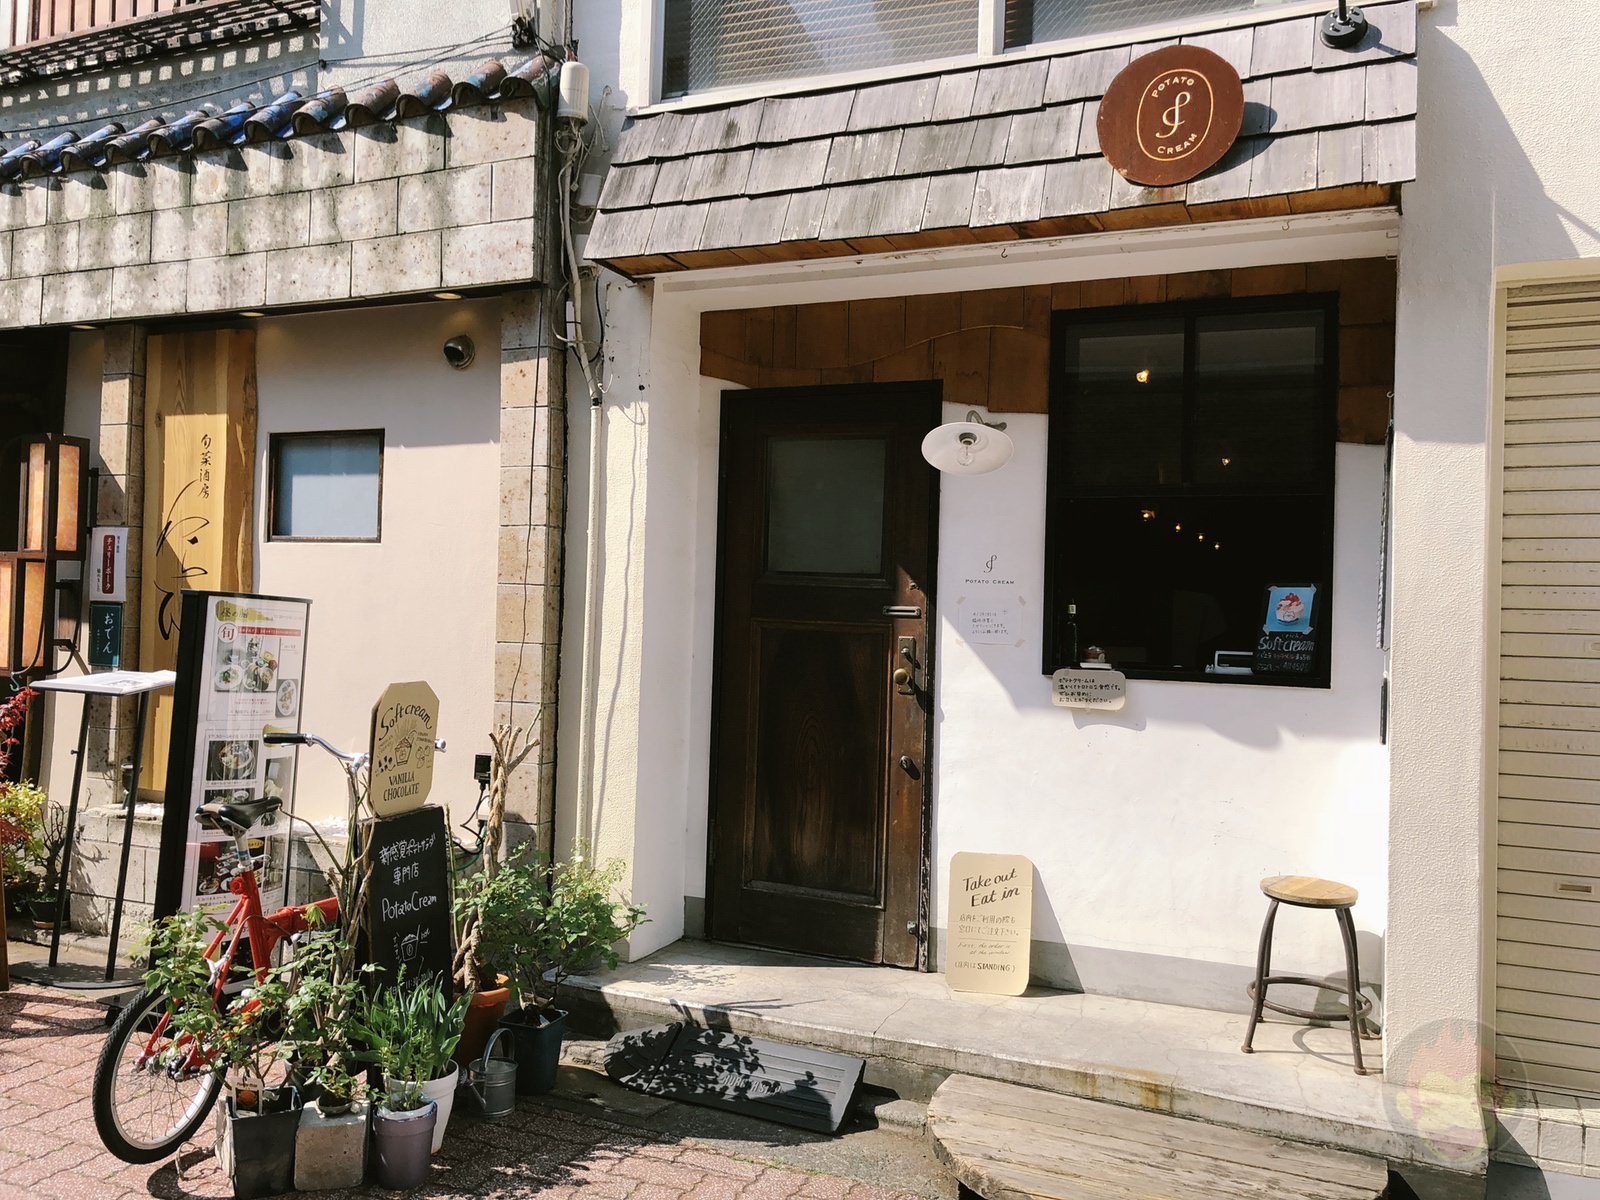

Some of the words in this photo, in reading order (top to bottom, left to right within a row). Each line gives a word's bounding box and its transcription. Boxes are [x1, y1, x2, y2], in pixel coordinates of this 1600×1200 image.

[1152, 76, 1195, 98] POTATO
[1157, 132, 1198, 155] CREAM
[199, 433, 212, 499] 旬菜酒房
[102, 613, 114, 654] おでん
[220, 626, 234, 640] 旬
[388, 771, 415, 786] VANILLA
[383, 782, 420, 802] CHOCOLATE
[393, 862, 420, 886] 専門店
[963, 875, 992, 892] Take
[994, 867, 1018, 883] out
[971, 890, 997, 907] Eat
[1001, 886, 1020, 901] in
